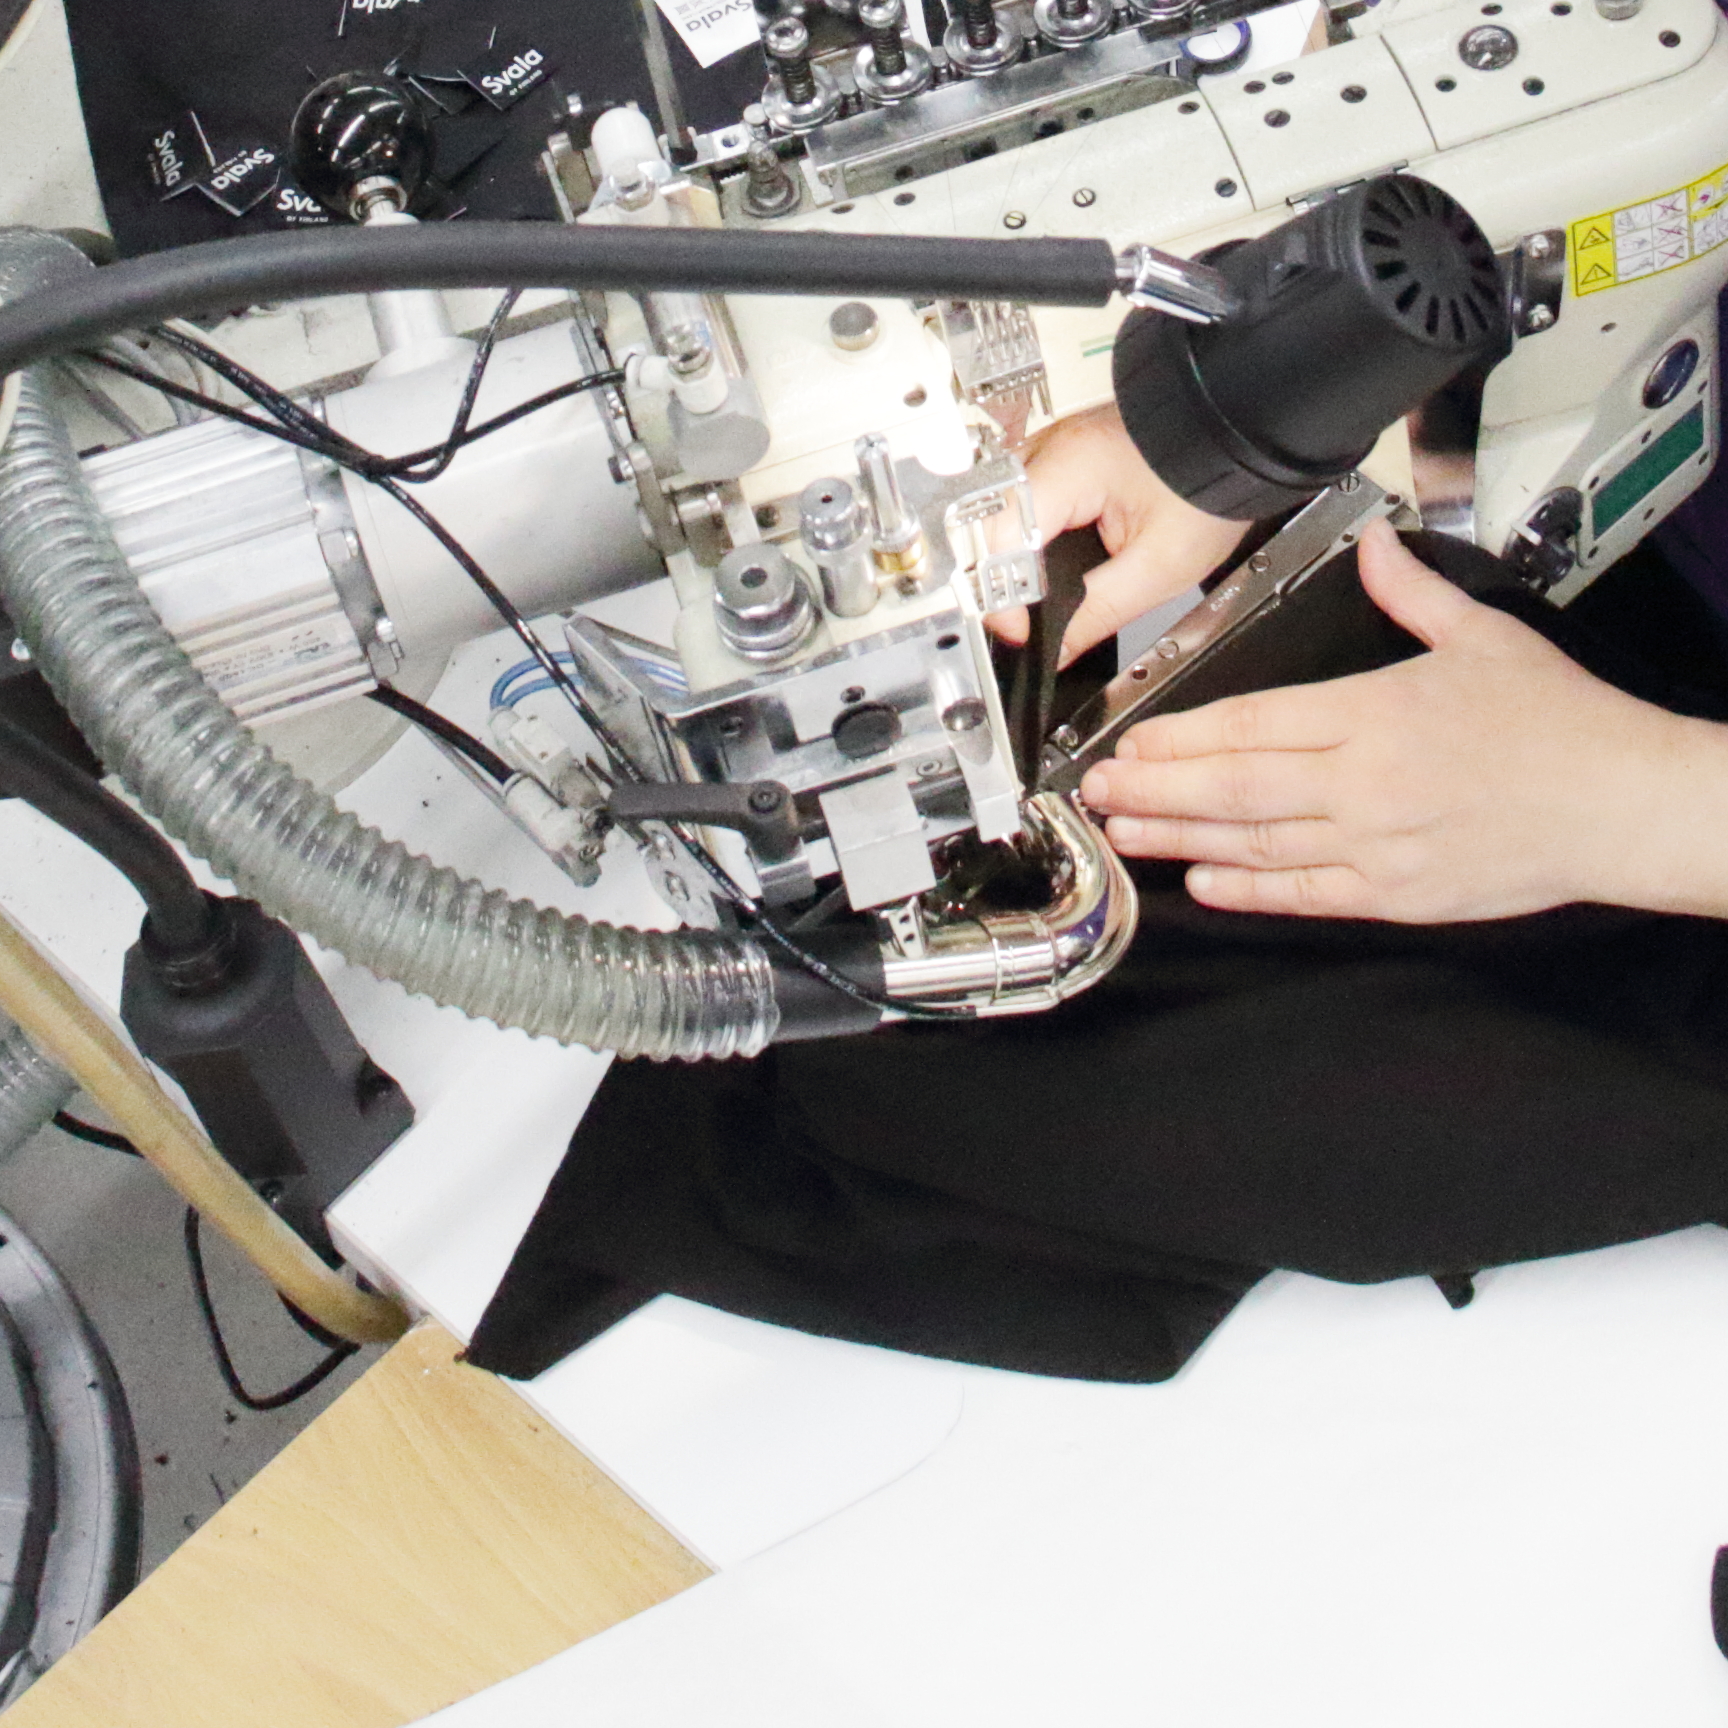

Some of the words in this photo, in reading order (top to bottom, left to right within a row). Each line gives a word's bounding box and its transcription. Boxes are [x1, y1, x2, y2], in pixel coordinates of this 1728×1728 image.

[481, 48, 544, 95] Svala
[155, 129, 183, 187] Svala
[210, 147, 275, 191] Svala
[276, 188, 322, 213] Sva
